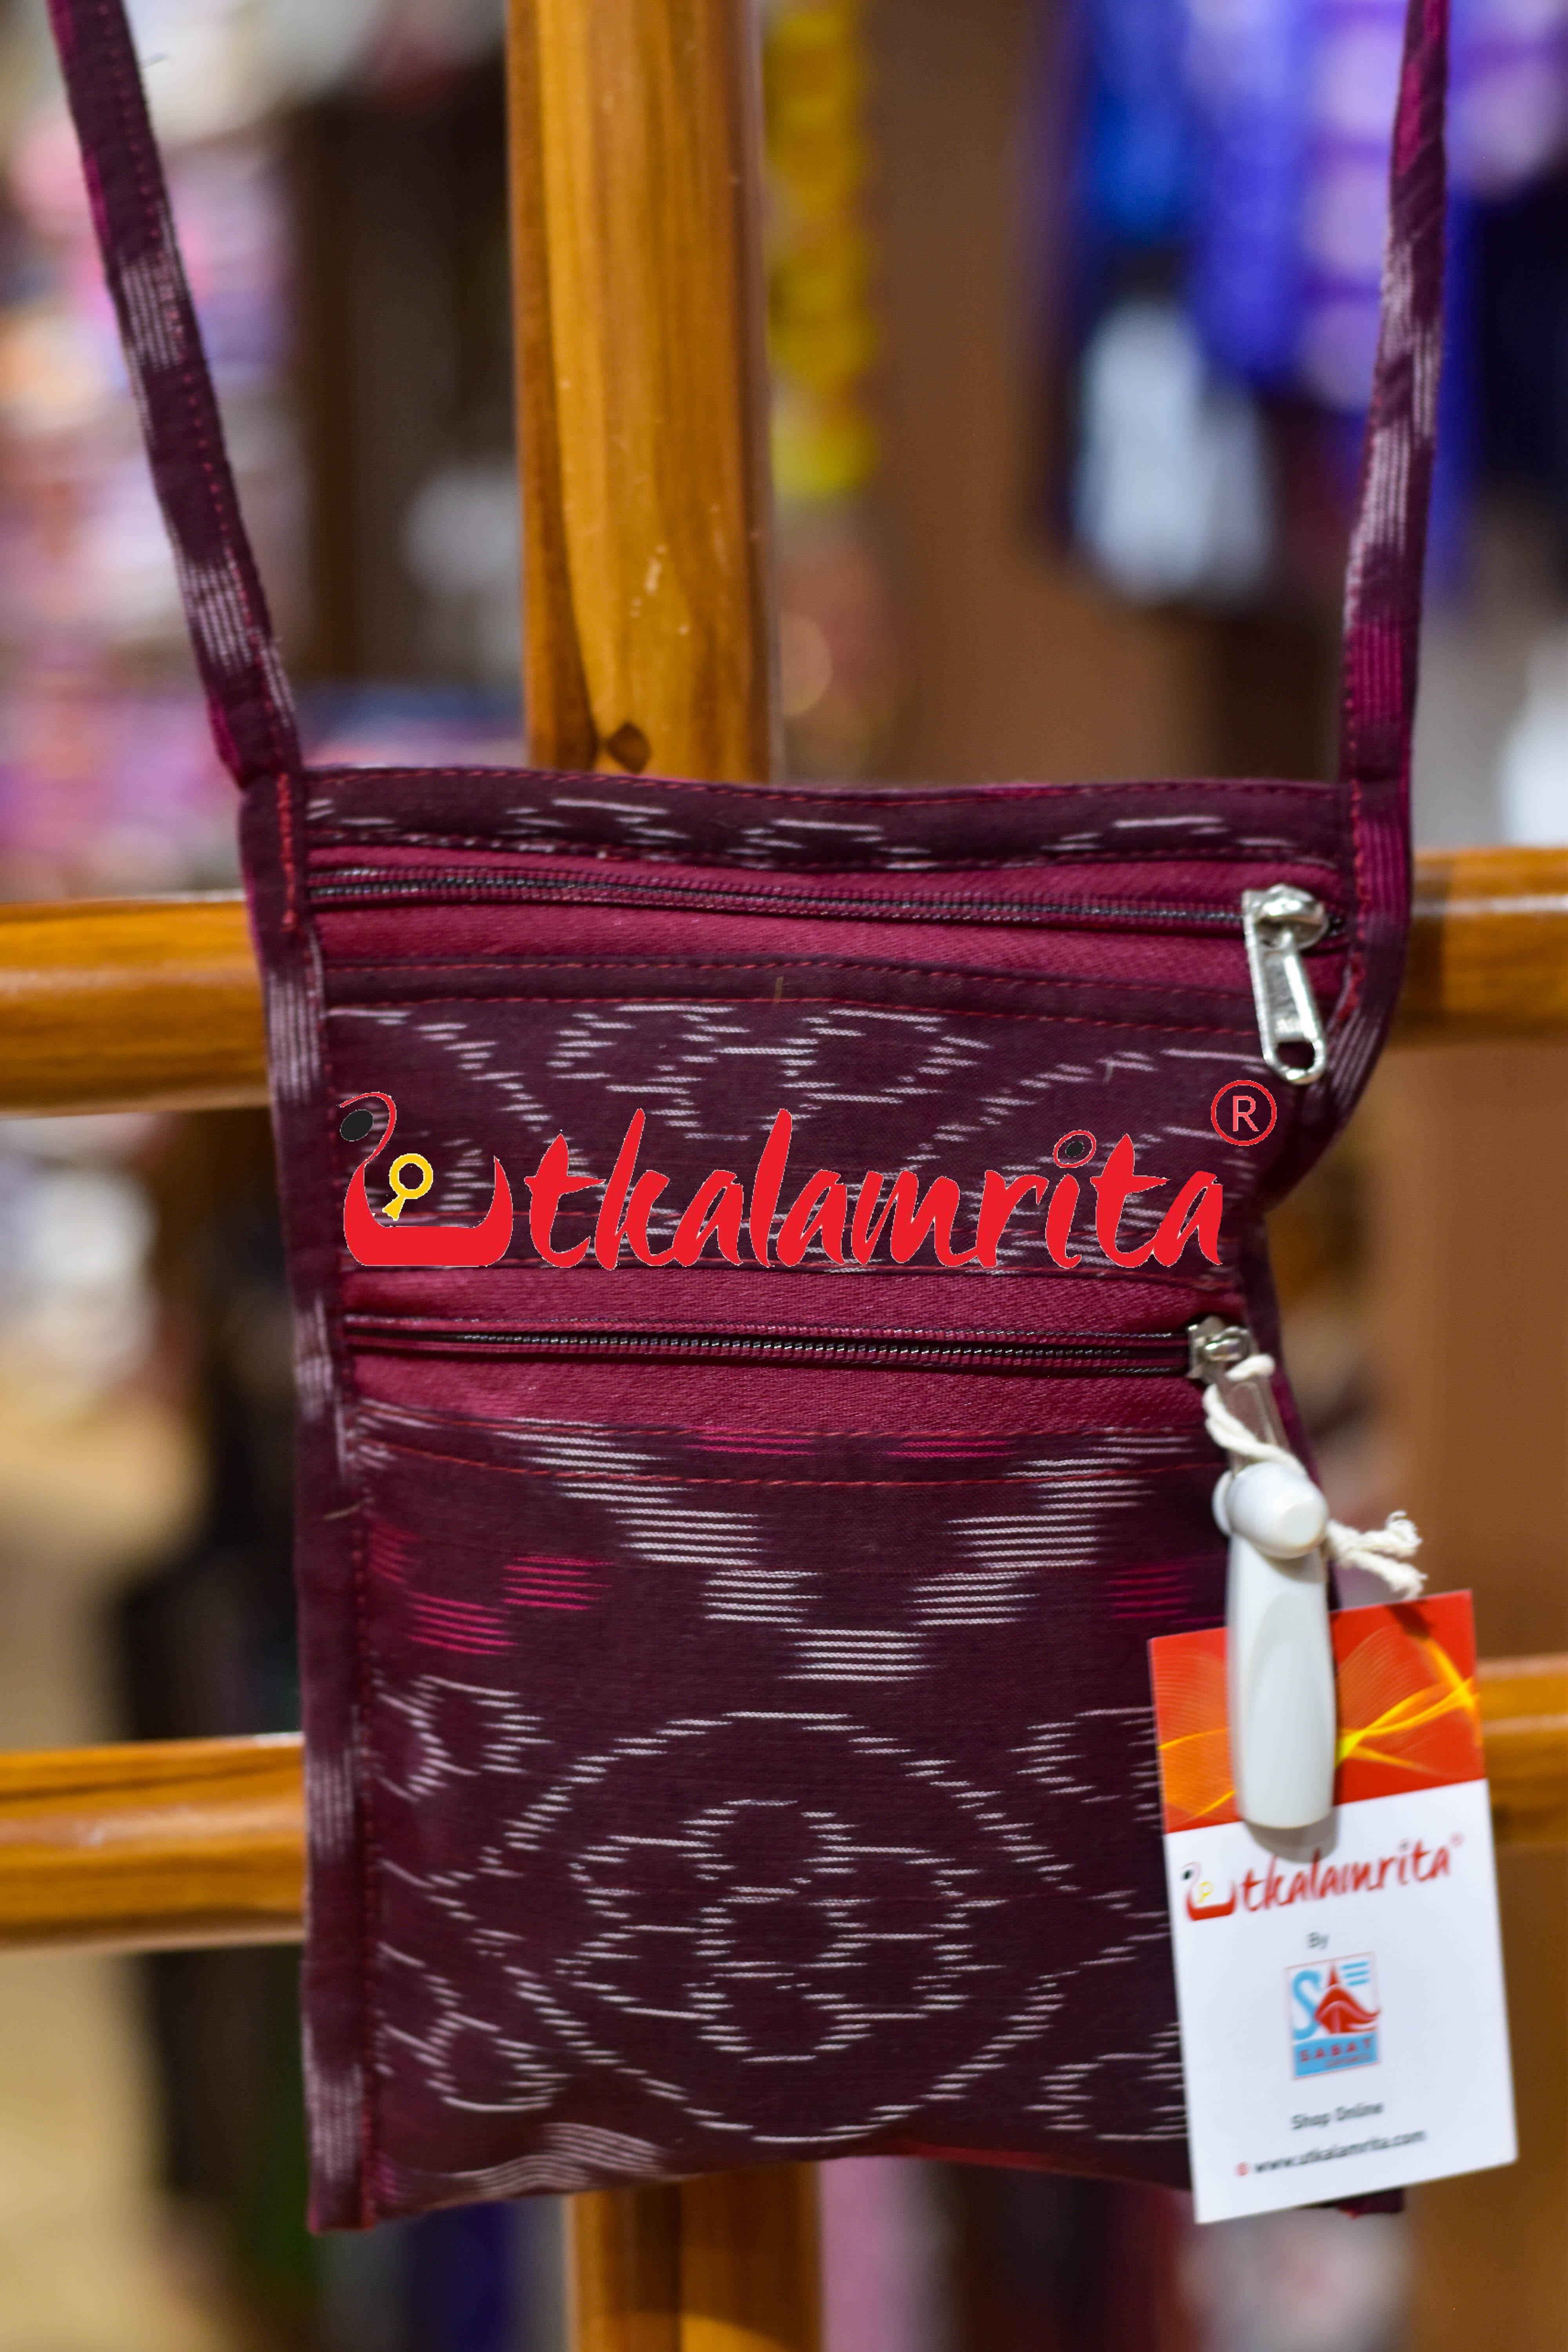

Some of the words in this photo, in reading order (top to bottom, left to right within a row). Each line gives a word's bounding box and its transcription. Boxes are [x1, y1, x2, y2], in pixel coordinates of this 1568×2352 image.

[1307, 1931, 1330, 1949] By
[1291, 2113, 1331, 2131] Shop
[1334, 2102, 1385, 2122] Online
